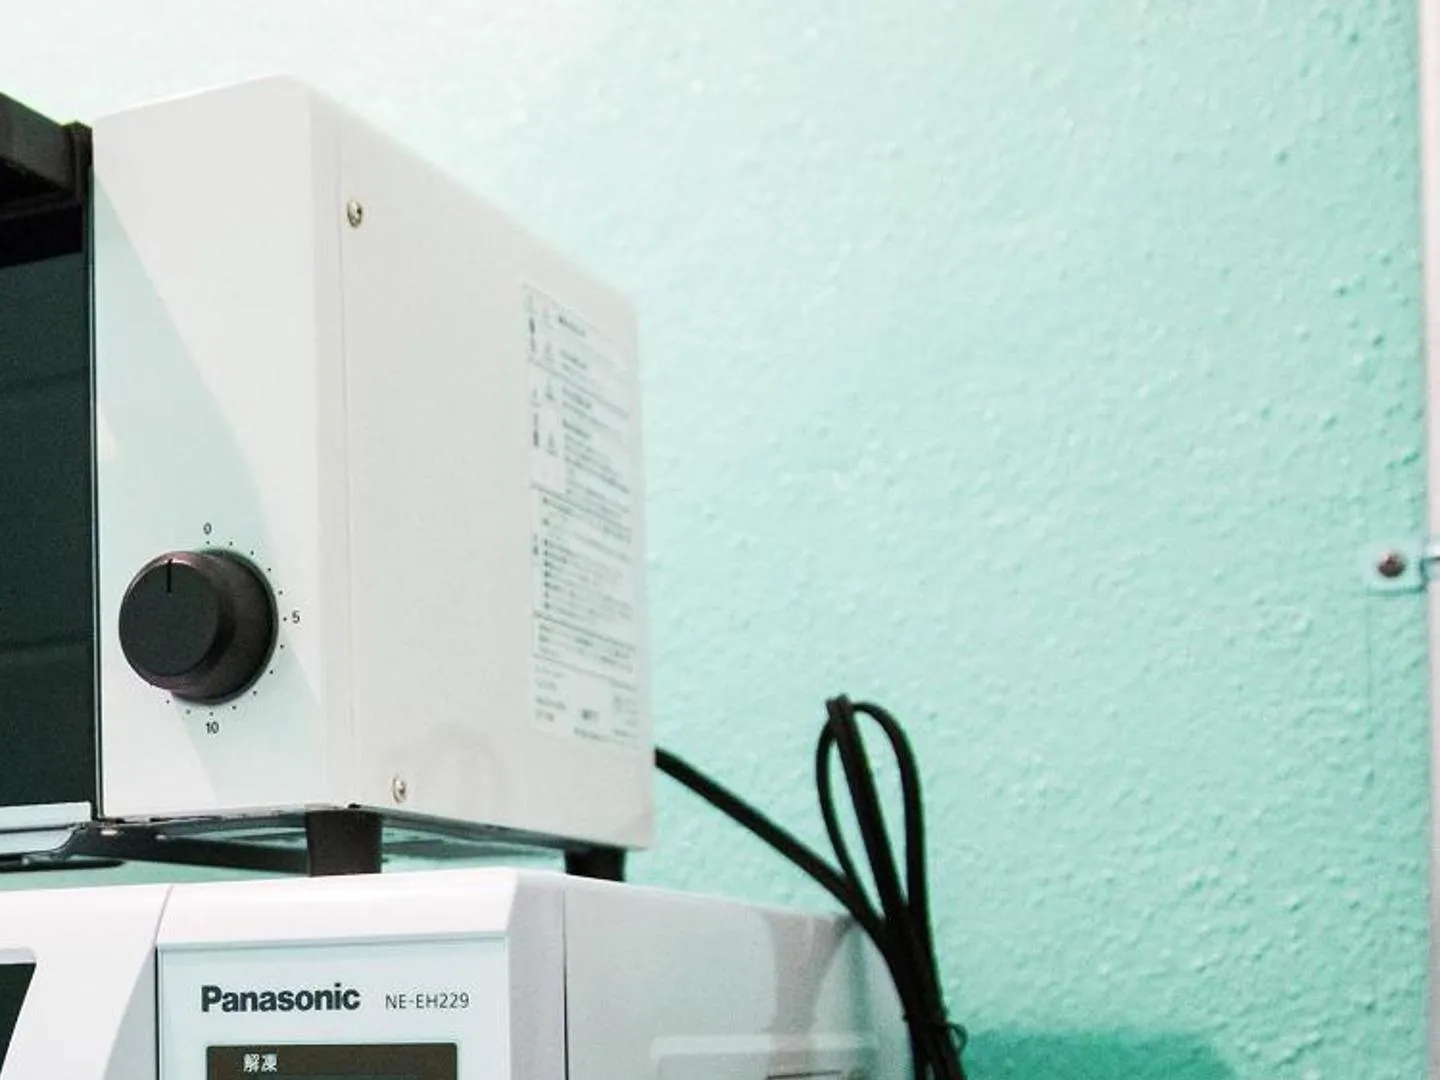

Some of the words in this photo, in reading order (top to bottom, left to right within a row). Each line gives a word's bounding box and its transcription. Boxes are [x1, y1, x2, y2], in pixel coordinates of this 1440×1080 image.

[203, 522, 212, 535] 0
[292, 610, 301, 624] 5
[205, 721, 220, 734] 10
[201, 982, 361, 1012] Panasonic
[385, 992, 471, 1010] NE-EH229
[243, 1053, 278, 1073] 解凍
